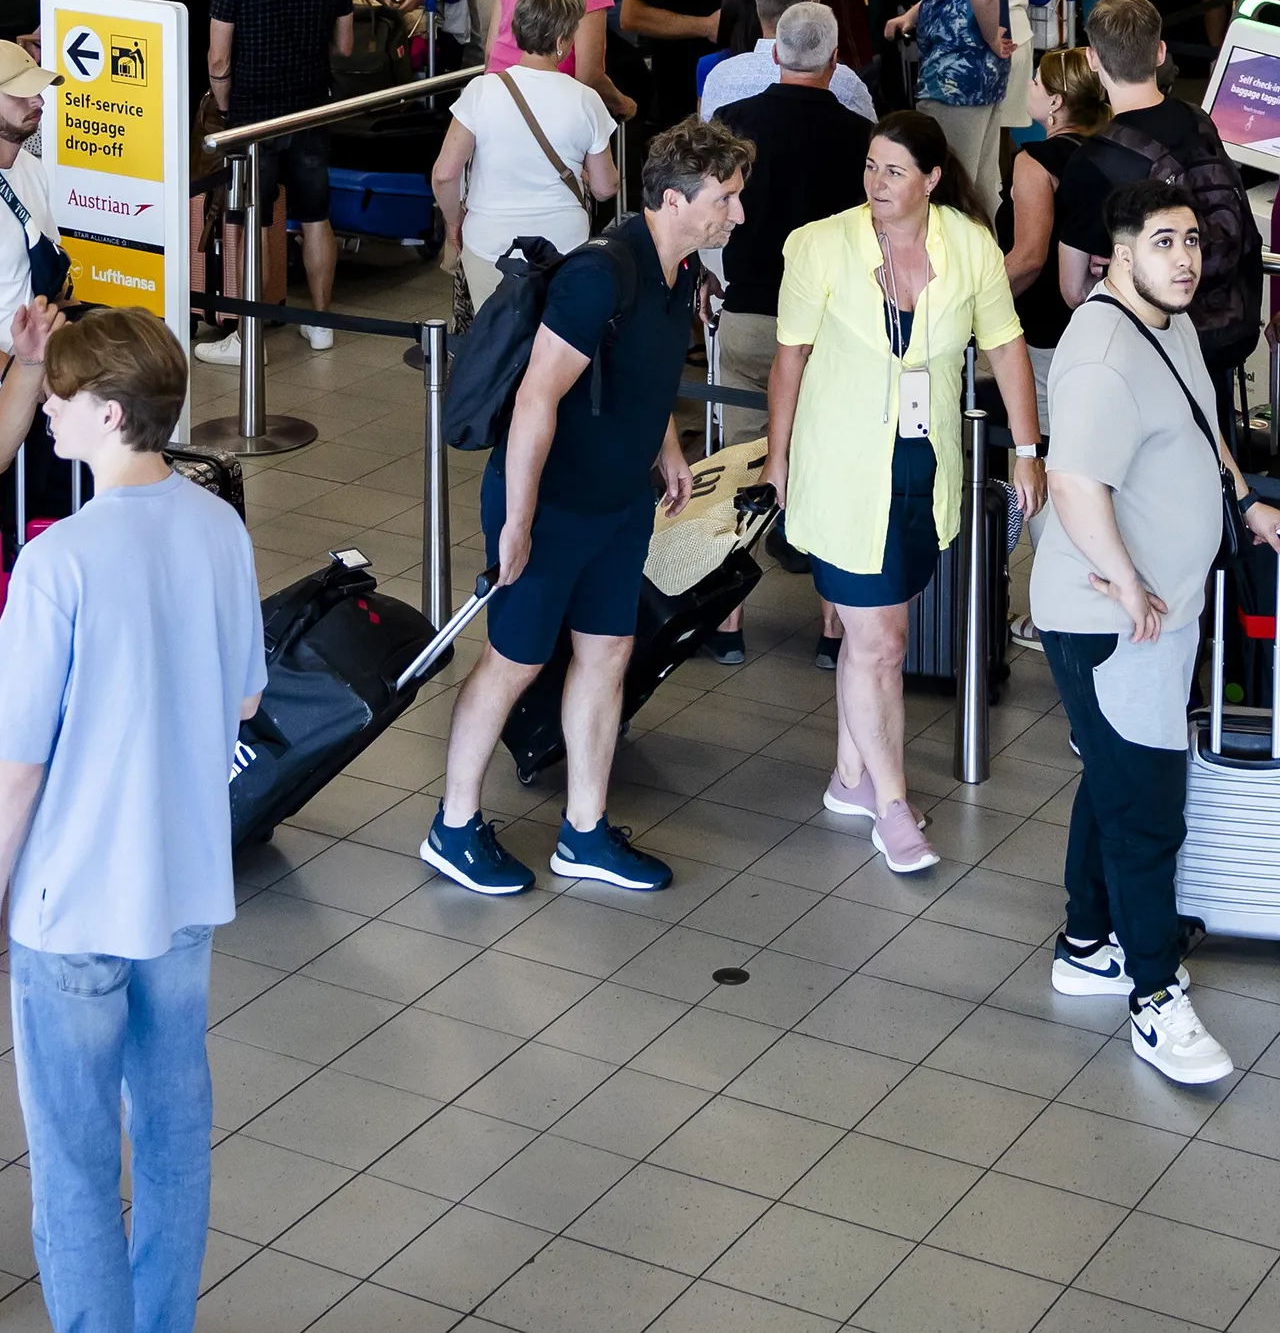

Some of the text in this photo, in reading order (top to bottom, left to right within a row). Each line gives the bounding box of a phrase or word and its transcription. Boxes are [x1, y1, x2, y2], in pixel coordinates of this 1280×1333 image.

[1230, 83, 1261, 100] baggage
[1239, 74, 1253, 85] Self
[1252, 78, 1280, 94] check-in
[65, 92, 144, 118] Self-service
[65, 113, 126, 139] baggage
[65, 135, 123, 158] drop-off
[68, 188, 130, 216] Austrian
[73, 230, 120, 246] STAR ALLIANCE
[91, 266, 156, 292] Lufthansa
